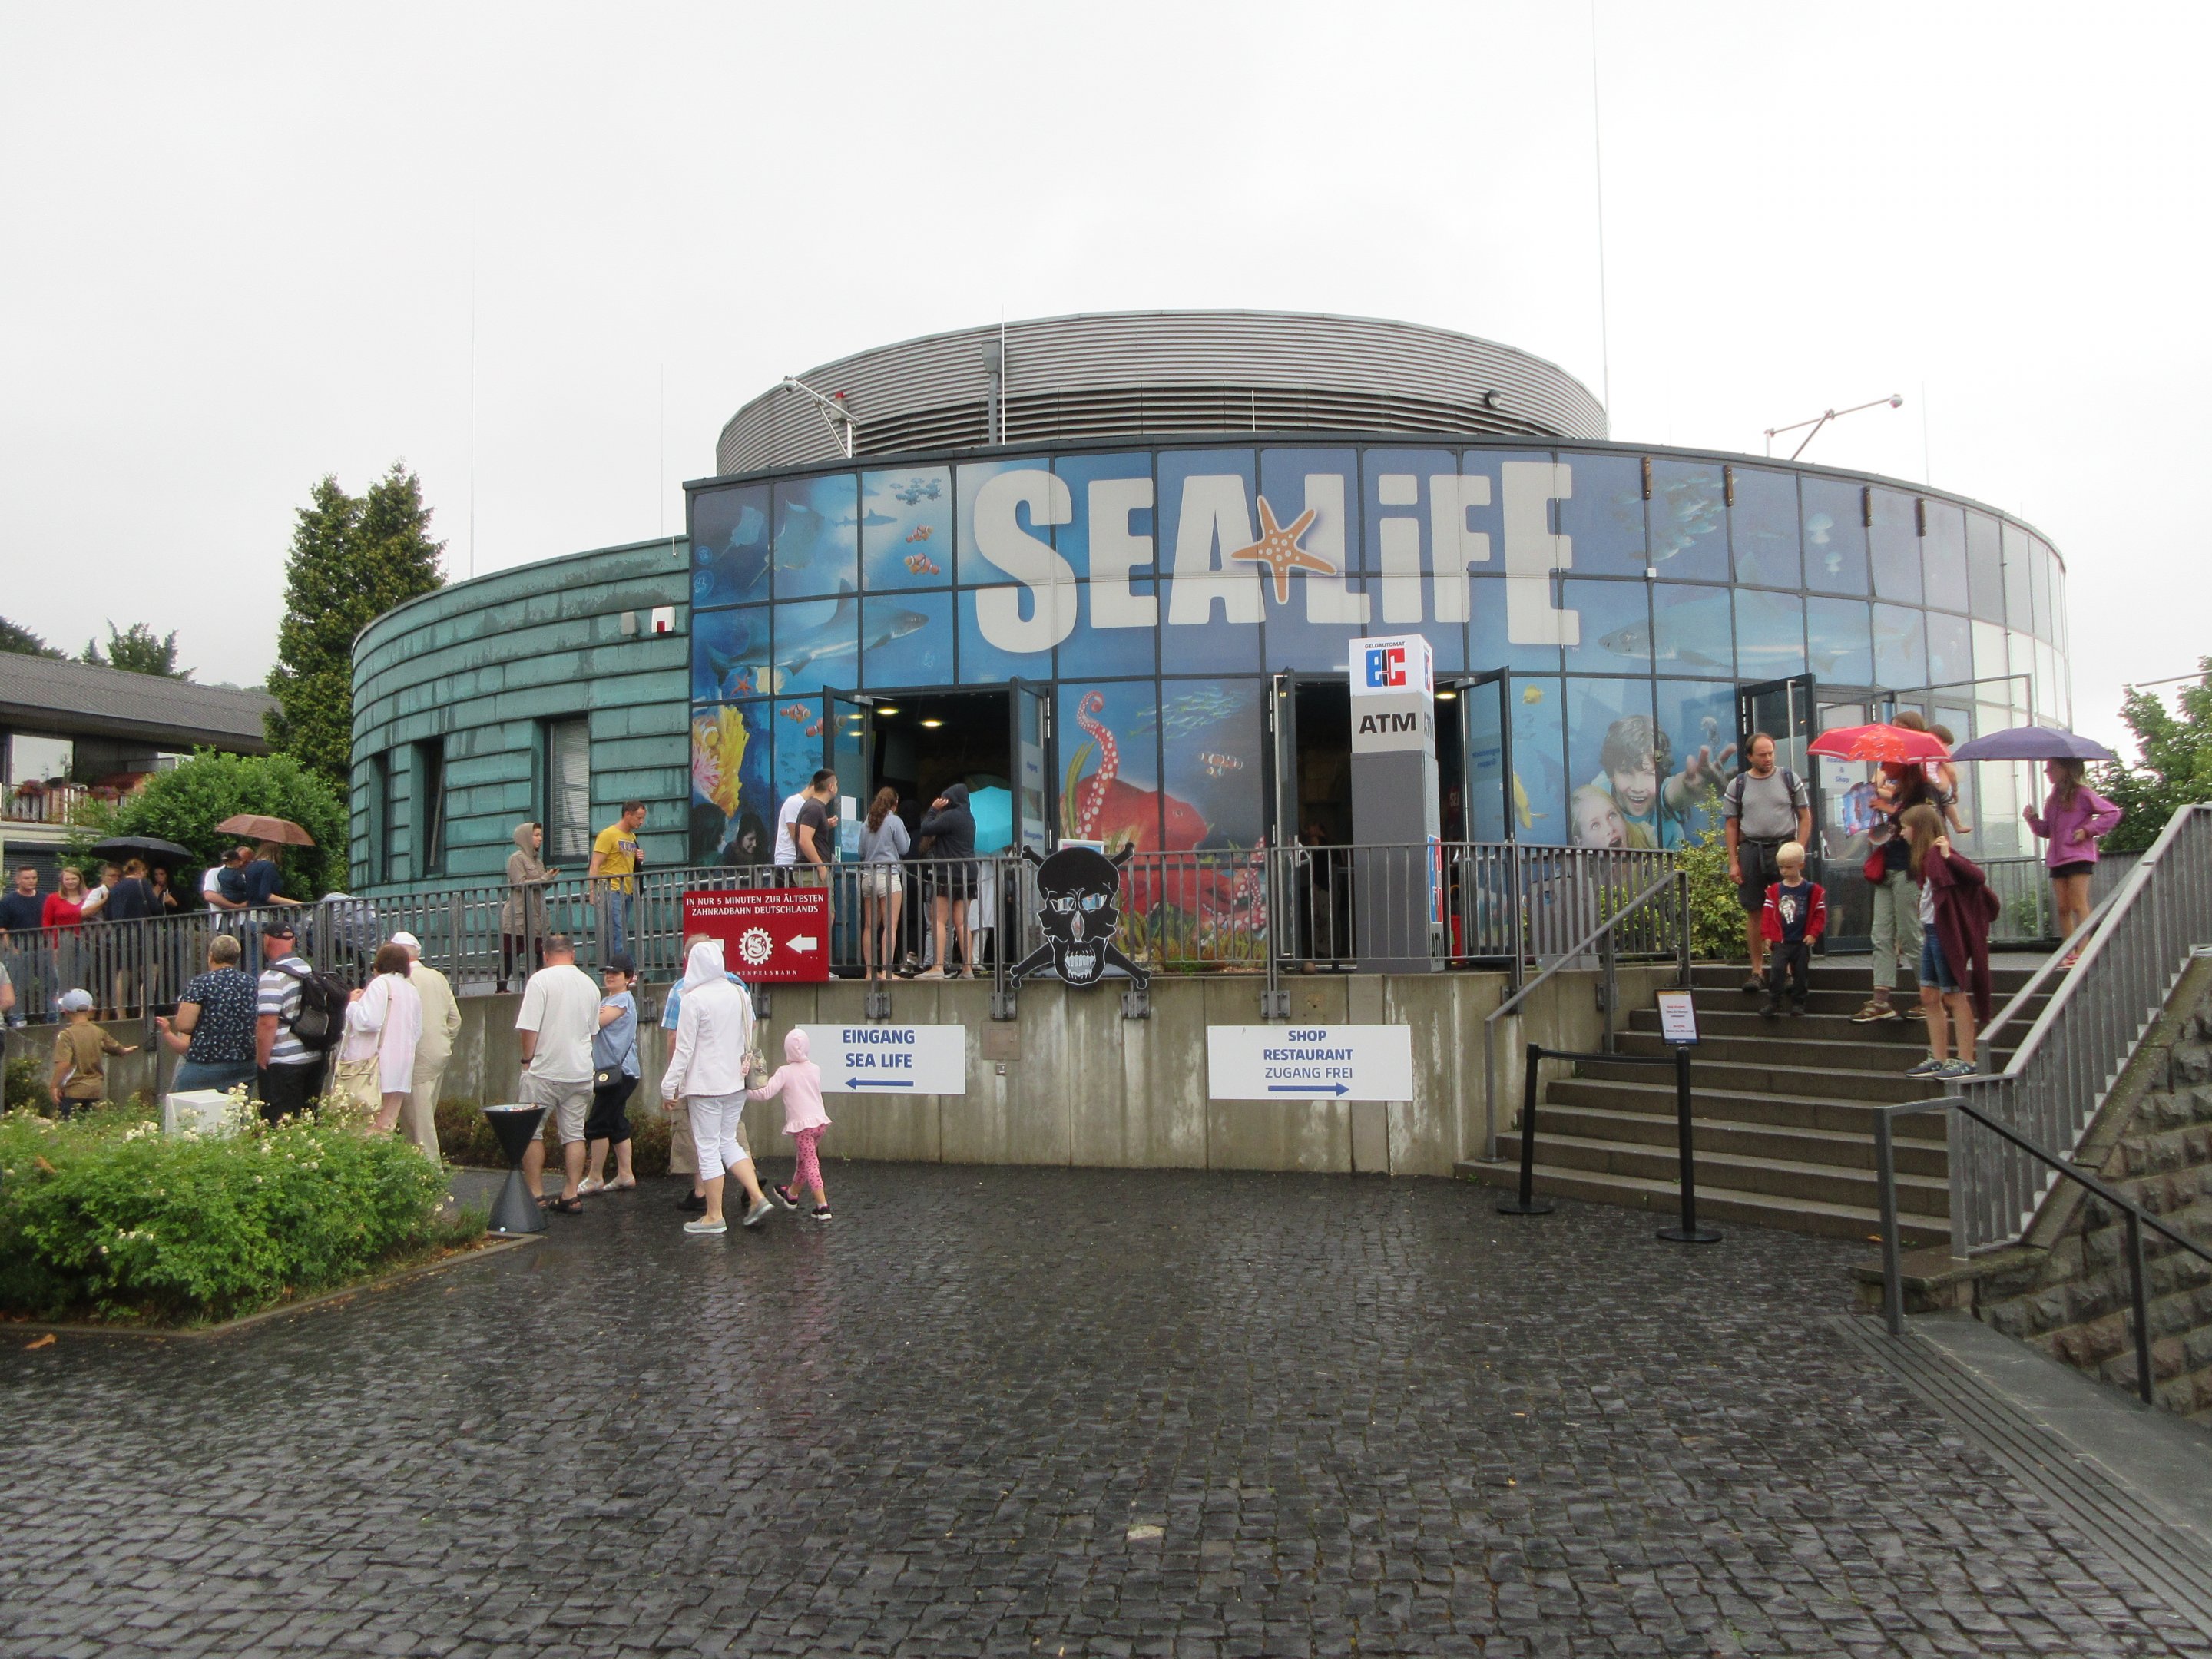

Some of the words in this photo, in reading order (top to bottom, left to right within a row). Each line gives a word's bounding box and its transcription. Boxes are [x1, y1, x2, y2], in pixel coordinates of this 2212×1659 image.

[973, 468, 1267, 654] SEA
[1359, 712, 1416, 734] ATM
[686, 897, 695, 906] IN
[697, 896, 714, 906] NUR
[717, 896, 722, 905] 5
[724, 895, 762, 905] MINUTEN
[764, 895, 781, 903] ZUR
[783, 893, 824, 903] ÄLTESTEN
[691, 906, 752, 916] ZAHNRADBAHN
[754, 905, 819, 915] DEUTSCHLANDS
[843, 1029, 916, 1045] EINGANG
[1288, 1030, 1327, 1042] SHOP
[846, 1052, 876, 1068] SEA
[881, 1053, 913, 1068] LIFE
[1263, 1048, 1353, 1061] RESTAURANT
[1265, 1067, 1321, 1079] ZUGANG
[1325, 1067, 1353, 1078] FREI
